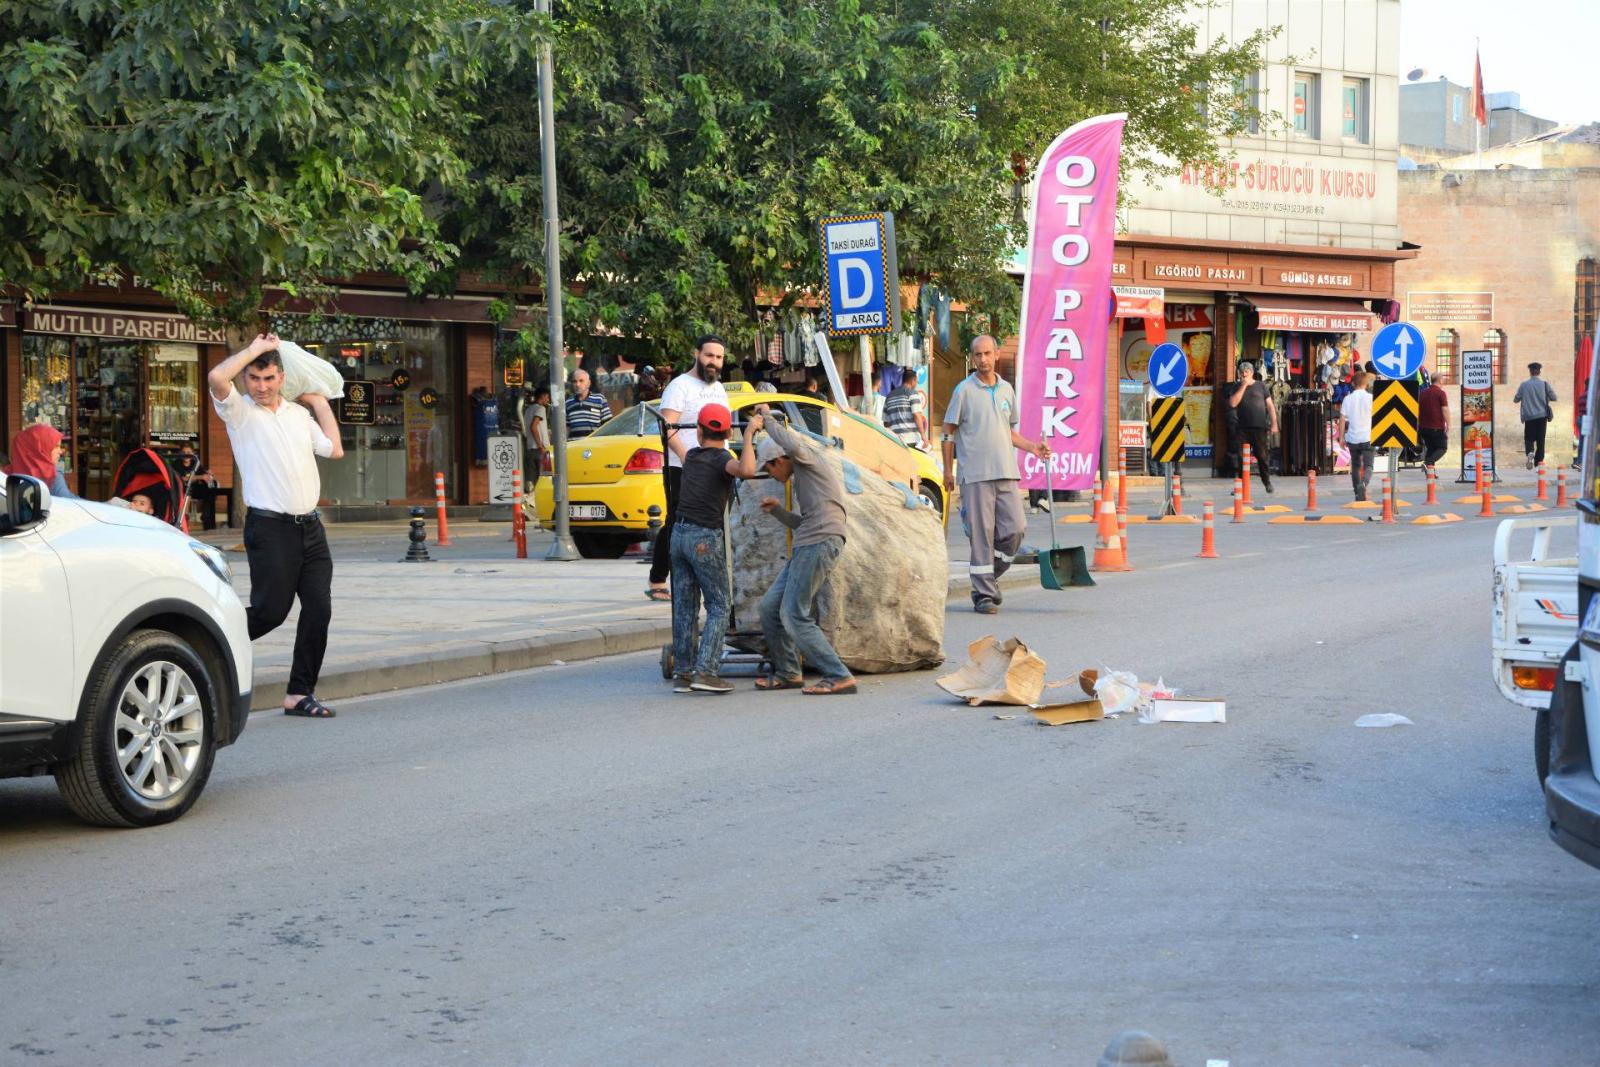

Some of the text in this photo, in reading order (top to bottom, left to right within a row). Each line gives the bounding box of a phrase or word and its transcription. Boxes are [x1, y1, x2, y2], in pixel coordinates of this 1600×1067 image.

[1245, 157, 1314, 194] SÜRÜCÜ
[1320, 168, 1376, 199] KURSU
[830, 238, 876, 250] TAKSİ DURAĞI
[1207, 267, 1246, 279] PASAJI
[1280, 271, 1352, 286] GÜMÜŞ ASKERİ
[837, 257, 874, 309] D
[1040, 155, 1096, 438] OTO PARK
[33, 312, 106, 335] MUTLU
[851, 313, 881, 326] ARAÇ
[1261, 313, 1368, 329] GÜMÜŞ ASKERİ MALZEME
[1024, 452, 1093, 481] ÇARŞIM
[579, 507, 584, 516] T
